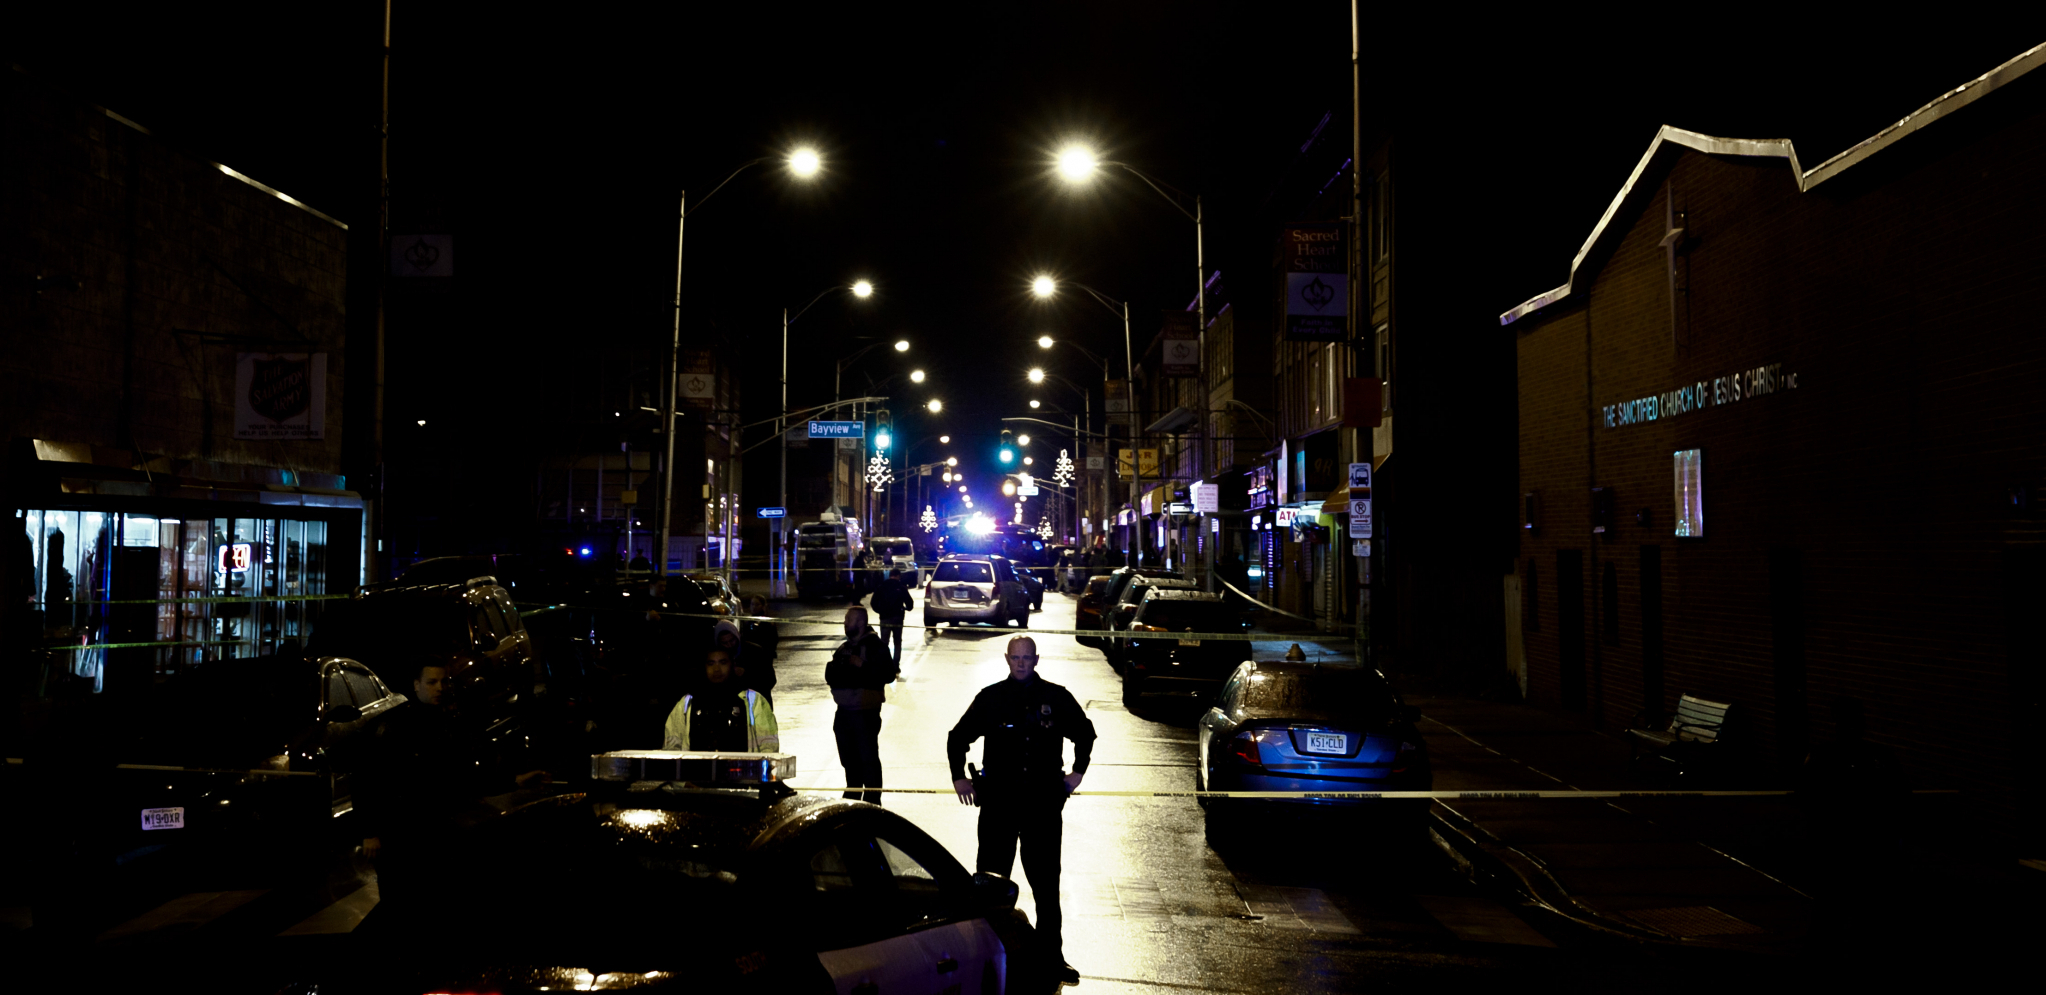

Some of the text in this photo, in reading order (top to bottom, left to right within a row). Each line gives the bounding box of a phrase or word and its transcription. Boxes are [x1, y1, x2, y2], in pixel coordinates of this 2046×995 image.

[1292, 228, 1340, 241] Sacred
[1297, 243, 1338, 256] Heart
[1294, 258, 1340, 271] School
[1292, 326, 1341, 335] Every Child
[262, 363, 285, 383] THE
[253, 367, 304, 405] SALVATION
[271, 386, 303, 414] ARMY
[1602, 404, 1616, 429] THE
[1618, 395, 1659, 426] SANCTIFIED
[1660, 385, 1694, 418] CHURCH
[1696, 381, 1708, 409] OF
[1711, 373, 1741, 406] JESUS
[811, 422, 849, 436] Bayview
